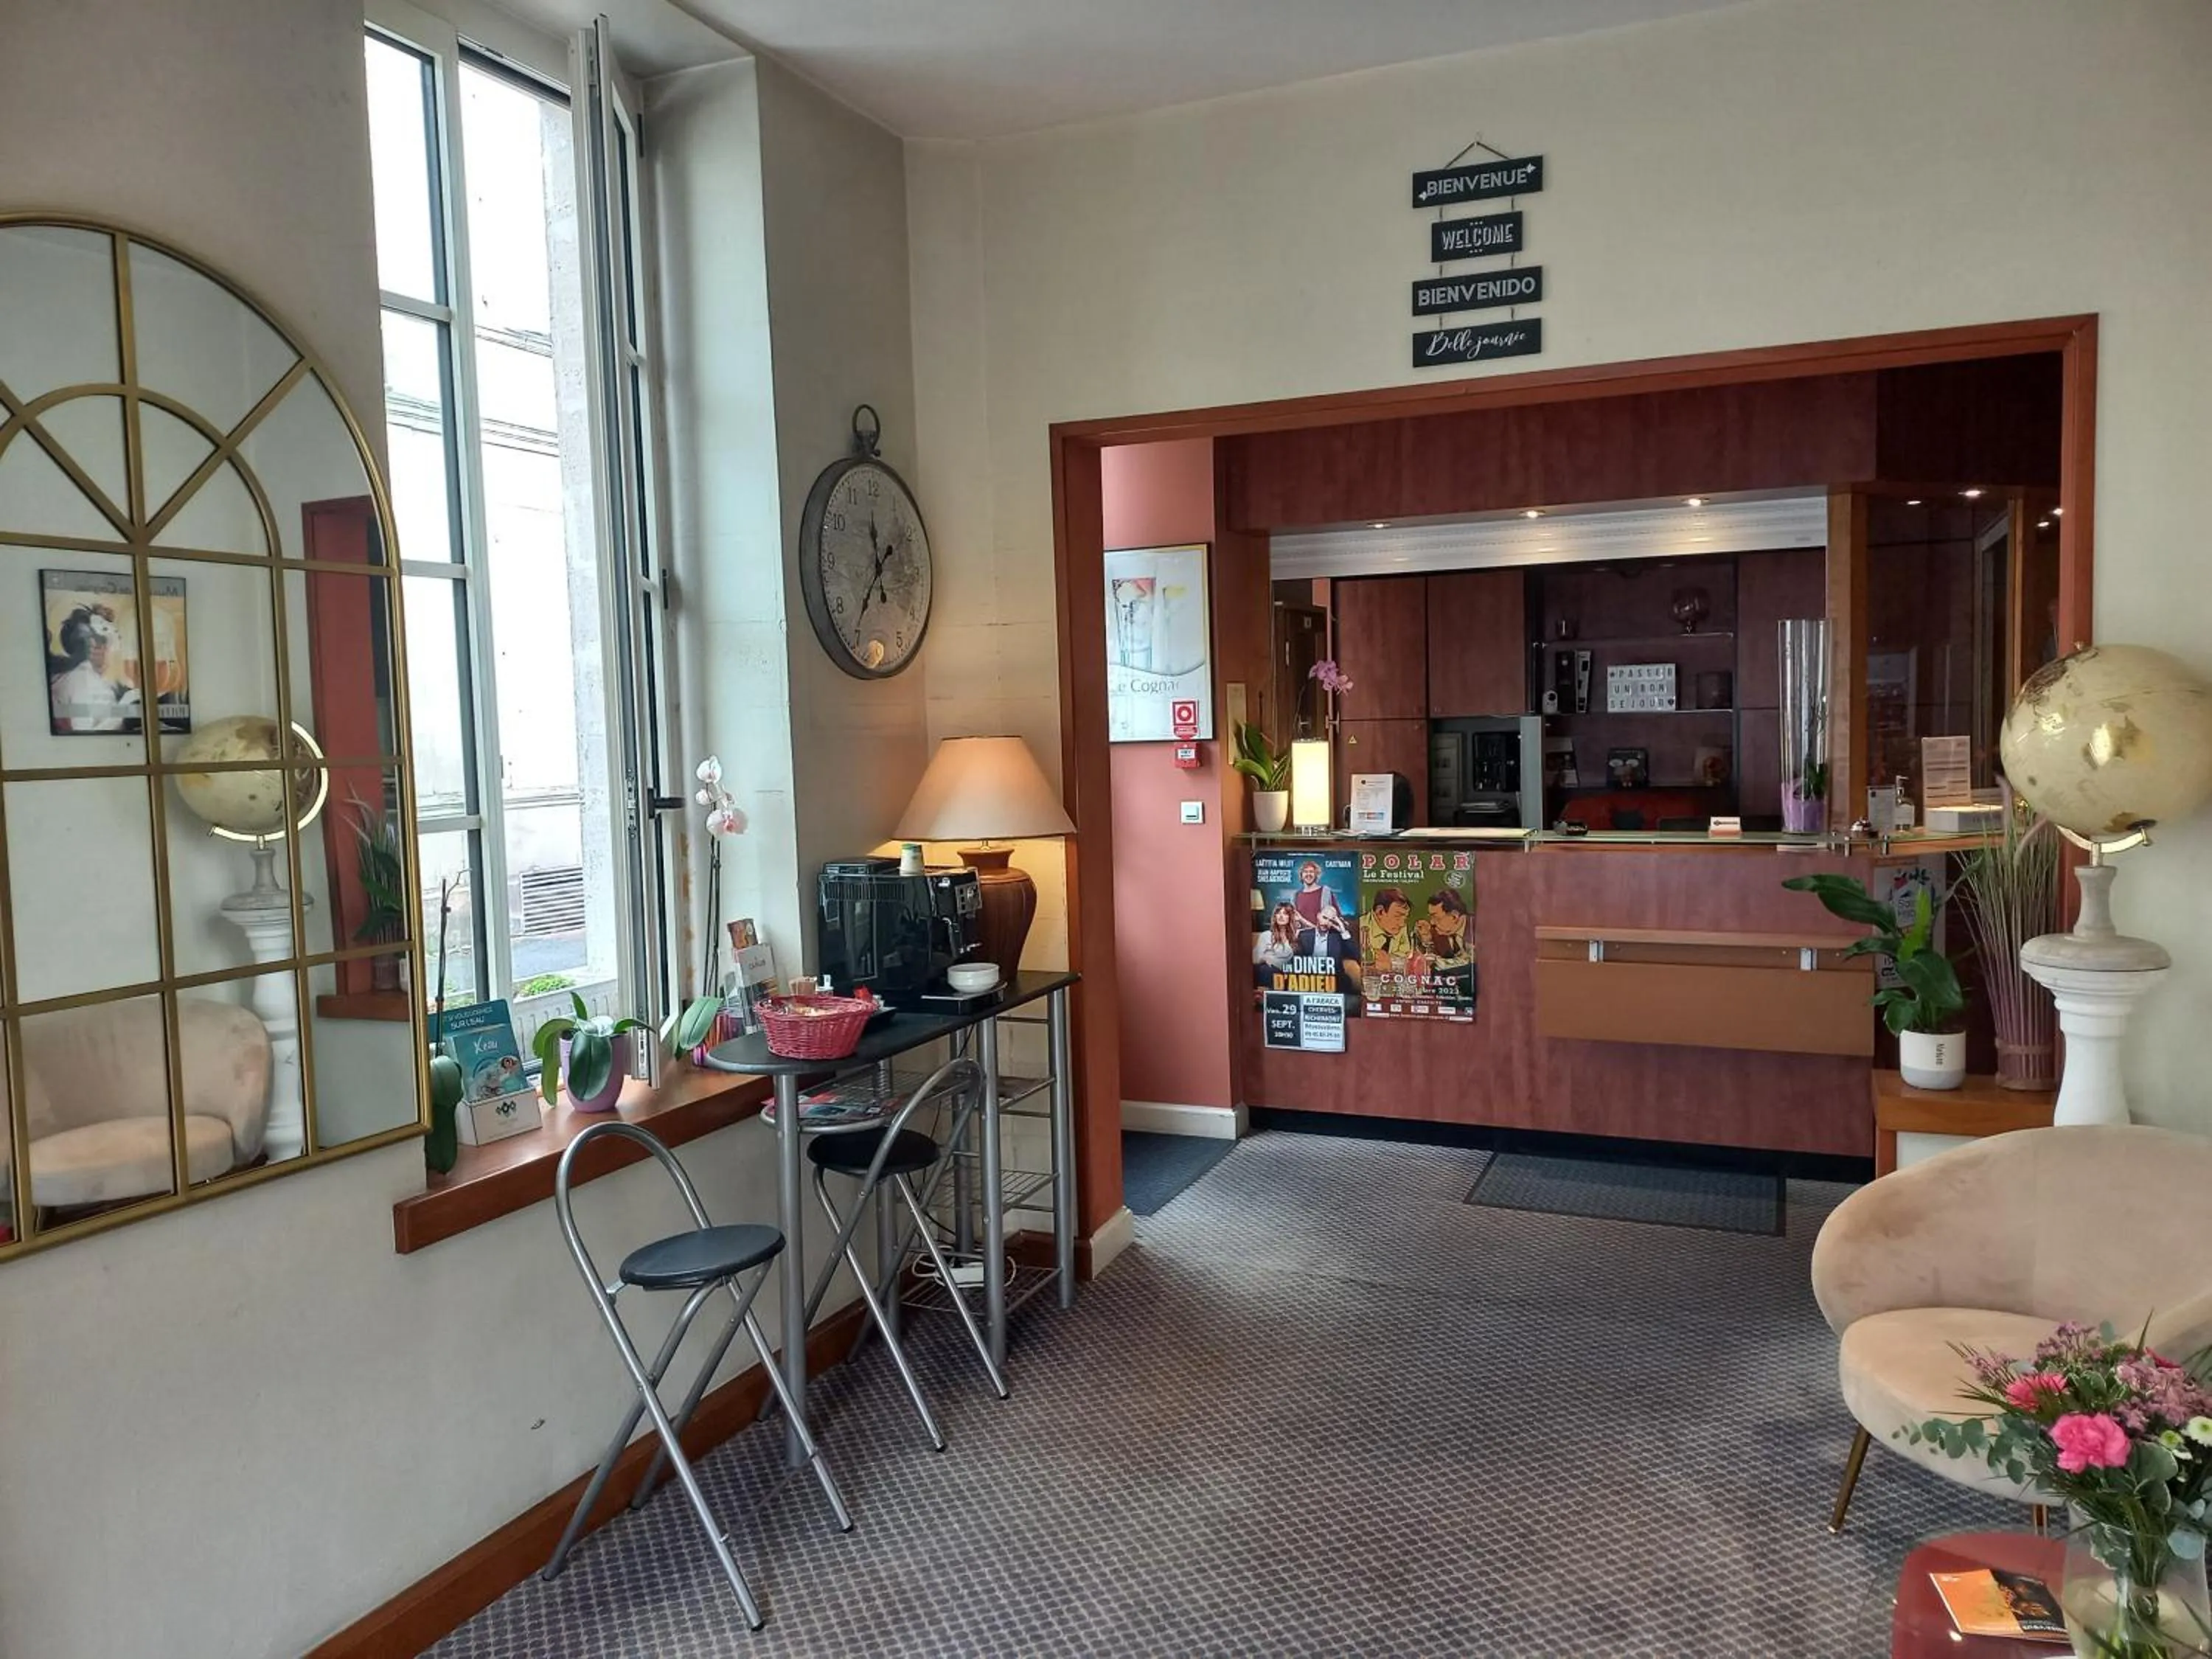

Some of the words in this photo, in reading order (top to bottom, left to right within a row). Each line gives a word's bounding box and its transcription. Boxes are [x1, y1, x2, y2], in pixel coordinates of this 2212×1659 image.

[1426, 168, 1528, 197] BIENVENUE
[1441, 223, 1514, 251] WELCOME
[1418, 276, 1536, 307] BIENVENIDO
[1426, 329, 1472, 356] Belle
[868, 479, 880, 498] 12
[833, 513, 846, 532] 10
[827, 552, 835, 569] 9
[835, 596, 844, 614] 8
[854, 629, 861, 647] 7
[896, 630, 903, 649] 5
[1362, 853, 1471, 871] POLAR
[1363, 870, 1377, 878] Le
[1380, 869, 1425, 879] Festival
[1273, 973, 1336, 992] D'ADIEU
[1380, 974, 1457, 986] COGNAC
[1282, 1004, 1297, 1015] 29
[1271, 1019, 1295, 1029] SEPT.
